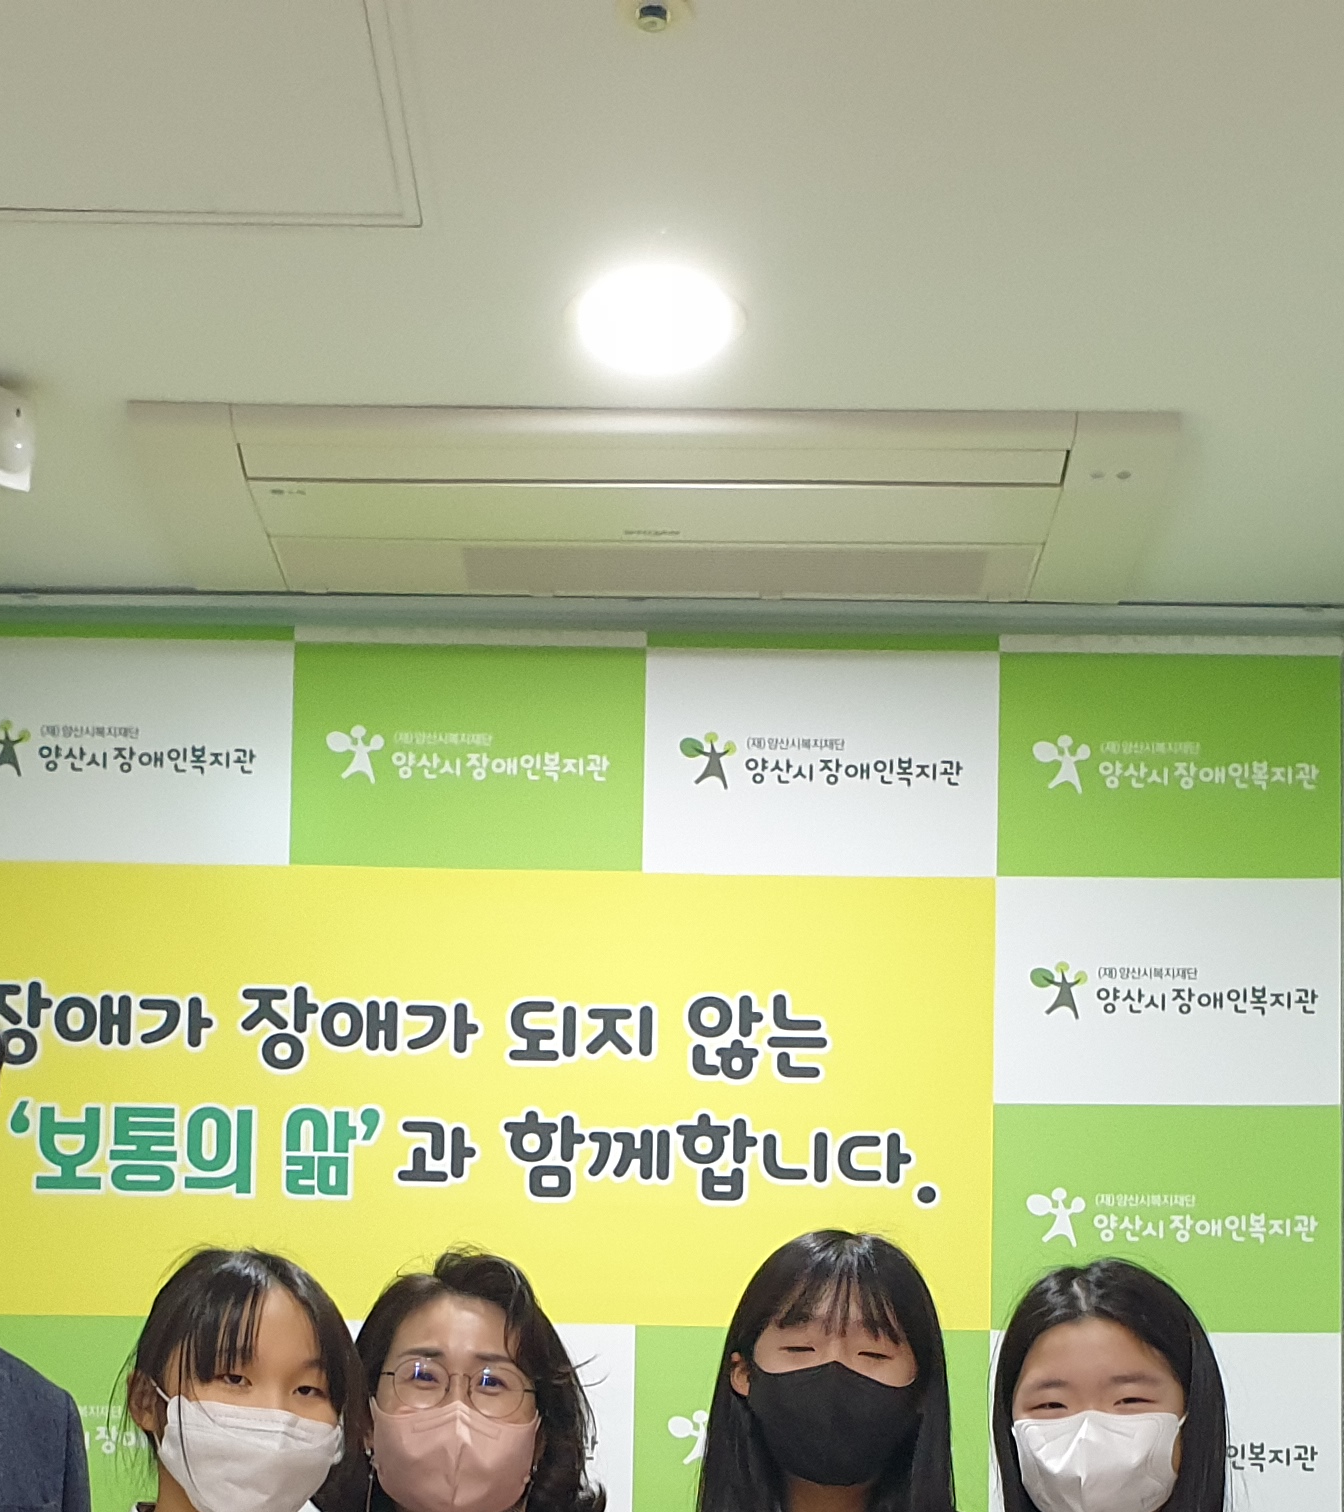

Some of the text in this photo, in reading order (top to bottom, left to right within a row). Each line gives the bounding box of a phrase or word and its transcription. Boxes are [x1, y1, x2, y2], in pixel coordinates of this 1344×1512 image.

[241, 984, 479, 1071] 장애가
[507, 1000, 654, 1064] 되지
[687, 993, 828, 1080] 않는
[503, 1109, 939, 1204] 함께합니다.
[1226, 1442, 1318, 1473] 인복지관
